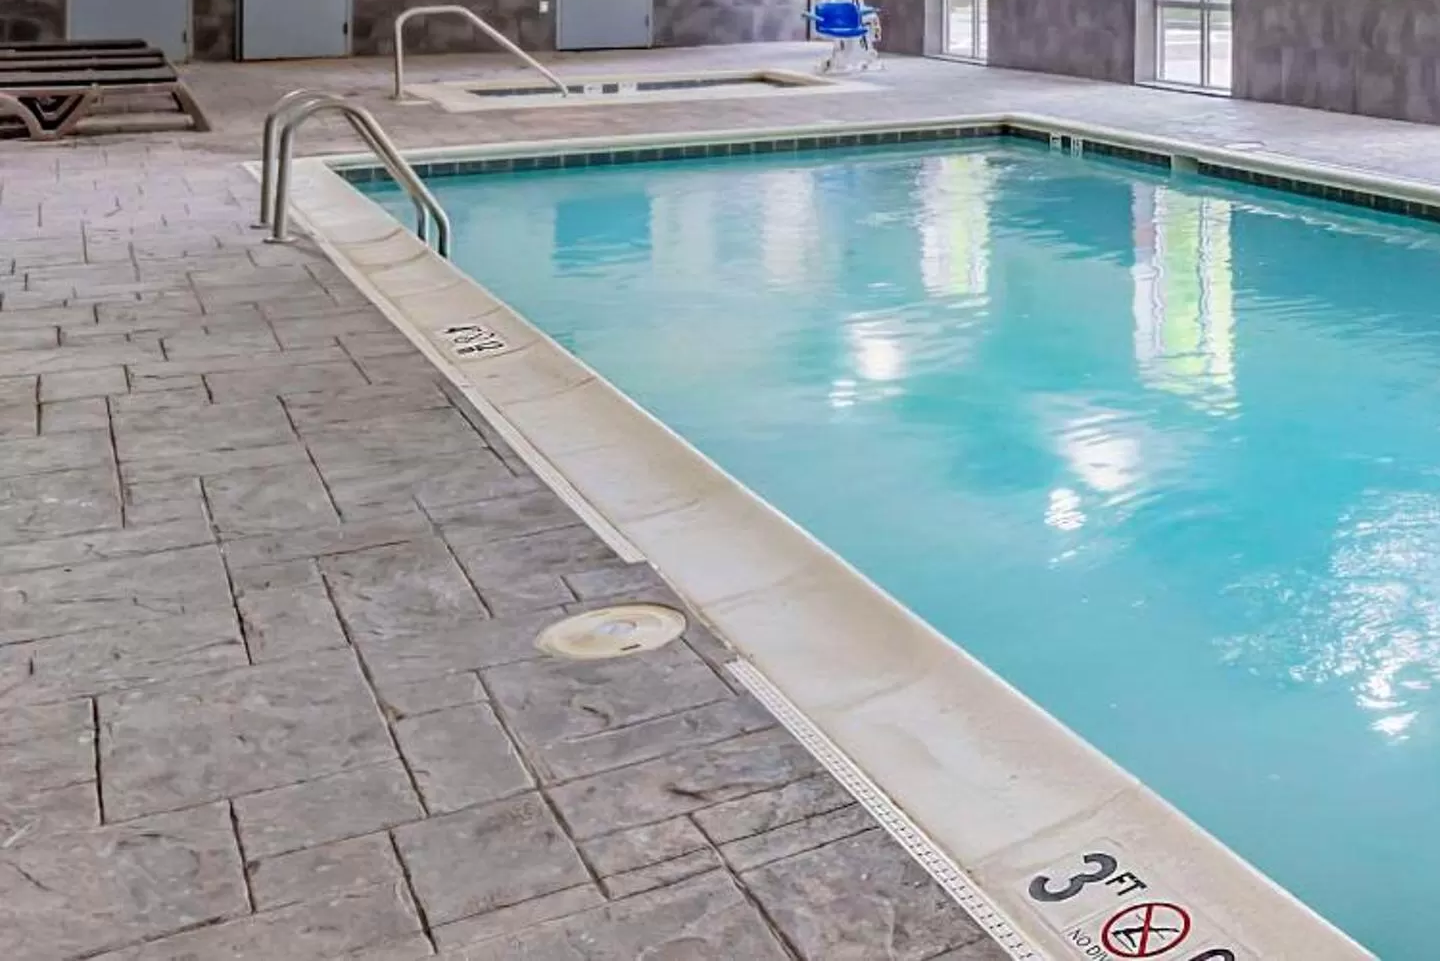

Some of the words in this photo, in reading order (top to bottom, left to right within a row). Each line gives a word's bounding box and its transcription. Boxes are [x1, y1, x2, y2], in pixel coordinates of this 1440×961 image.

[1028, 852, 1118, 903] 3
[1104, 869, 1148, 897] FT
[1067, 928, 1092, 946] NO
